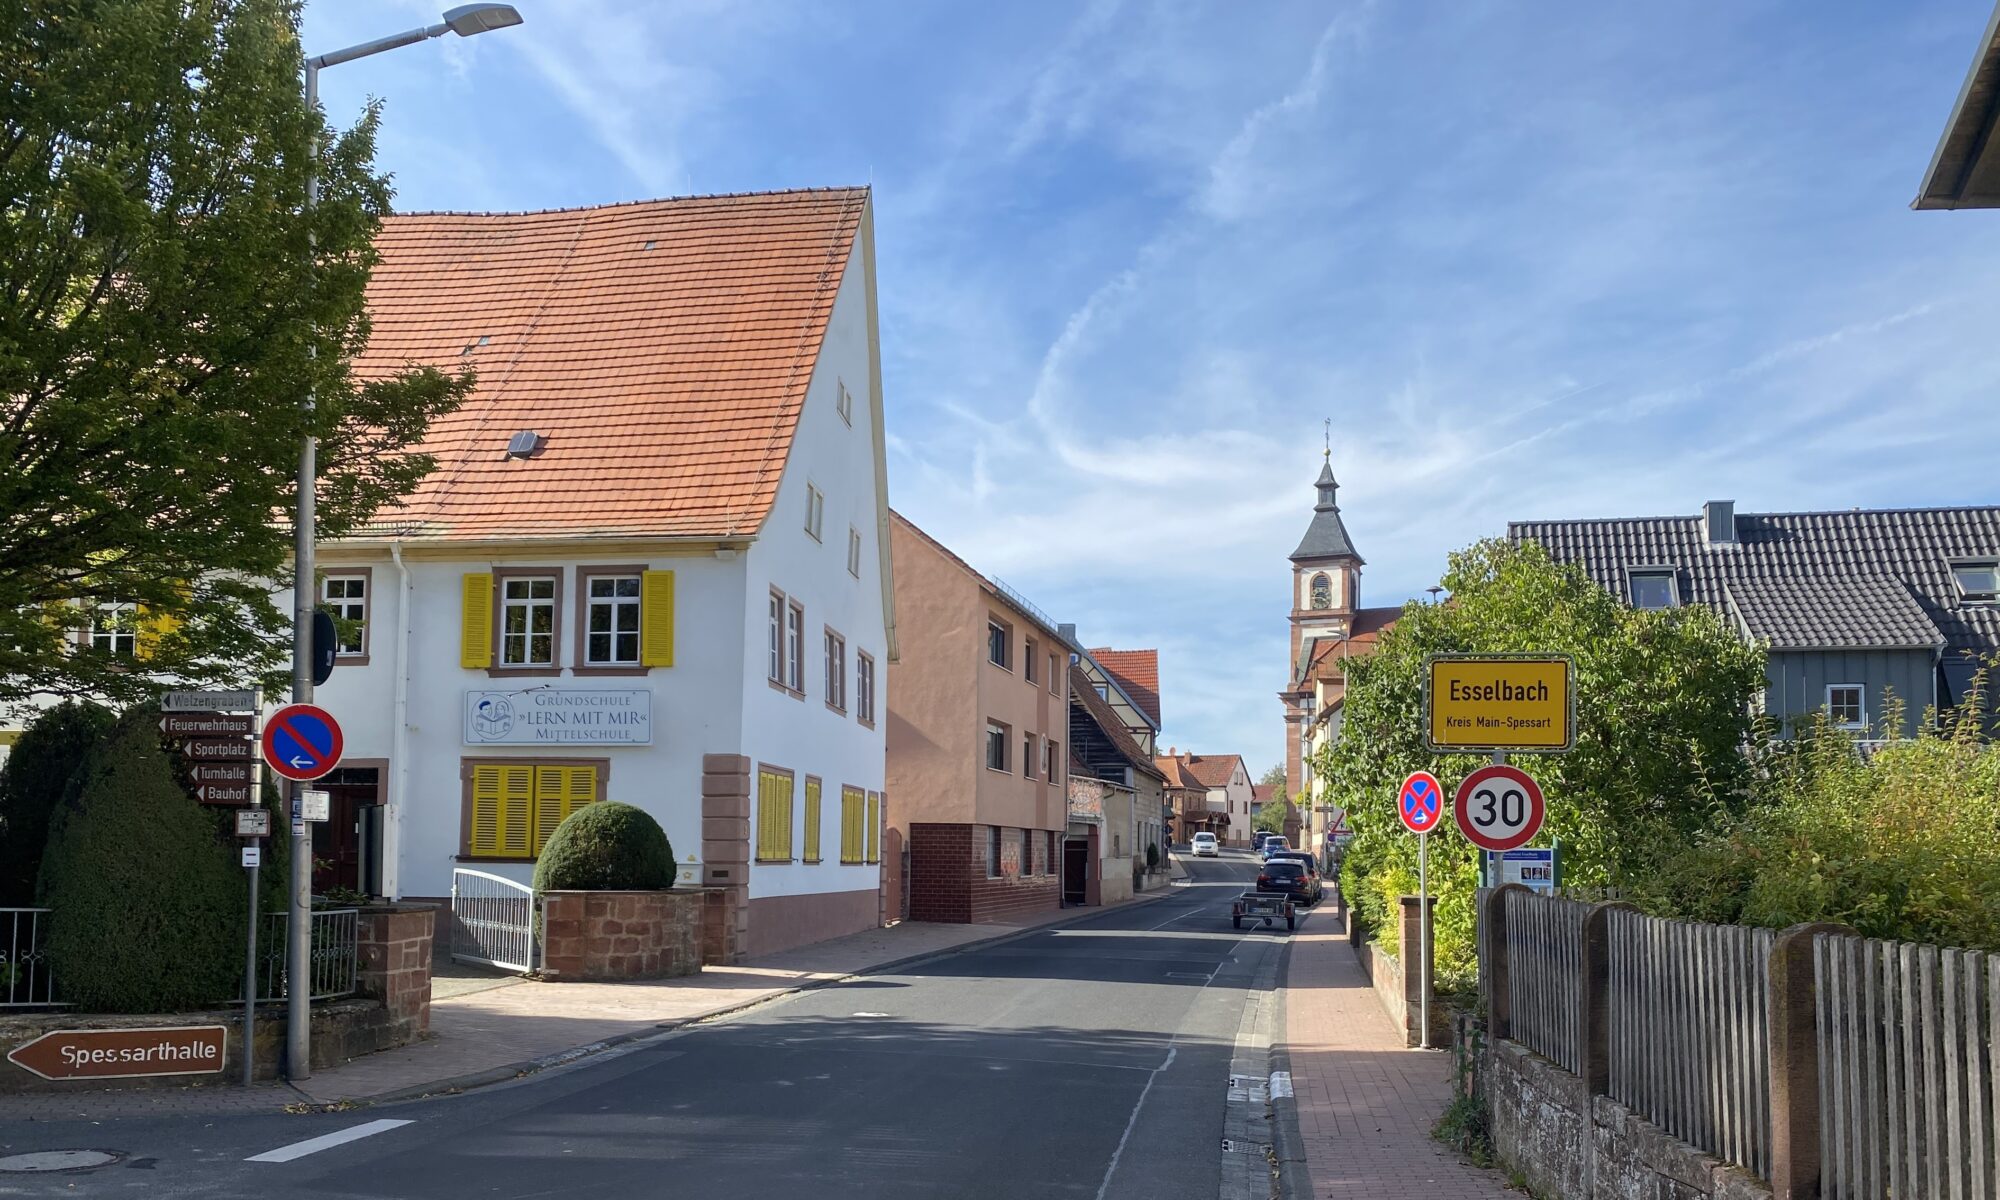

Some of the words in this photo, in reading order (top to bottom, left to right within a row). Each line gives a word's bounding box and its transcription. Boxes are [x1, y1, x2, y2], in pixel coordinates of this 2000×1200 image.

[1450, 679, 1548, 701] Esselbach
[169, 718, 248, 731] Feuerwehrhaus
[519, 711, 566, 725] »LERN
[572, 711, 603, 725] MIT
[1446, 715, 1472, 728] Kreis
[1476, 715, 1551, 730] Main-Spessart
[195, 742, 247, 757] Sportplatz
[200, 766, 246, 779] Turnhalle
[208, 786, 247, 800] Bauhof
[1474, 789, 1524, 827] 30
[60, 1041, 217, 1068] Spessarthalle
